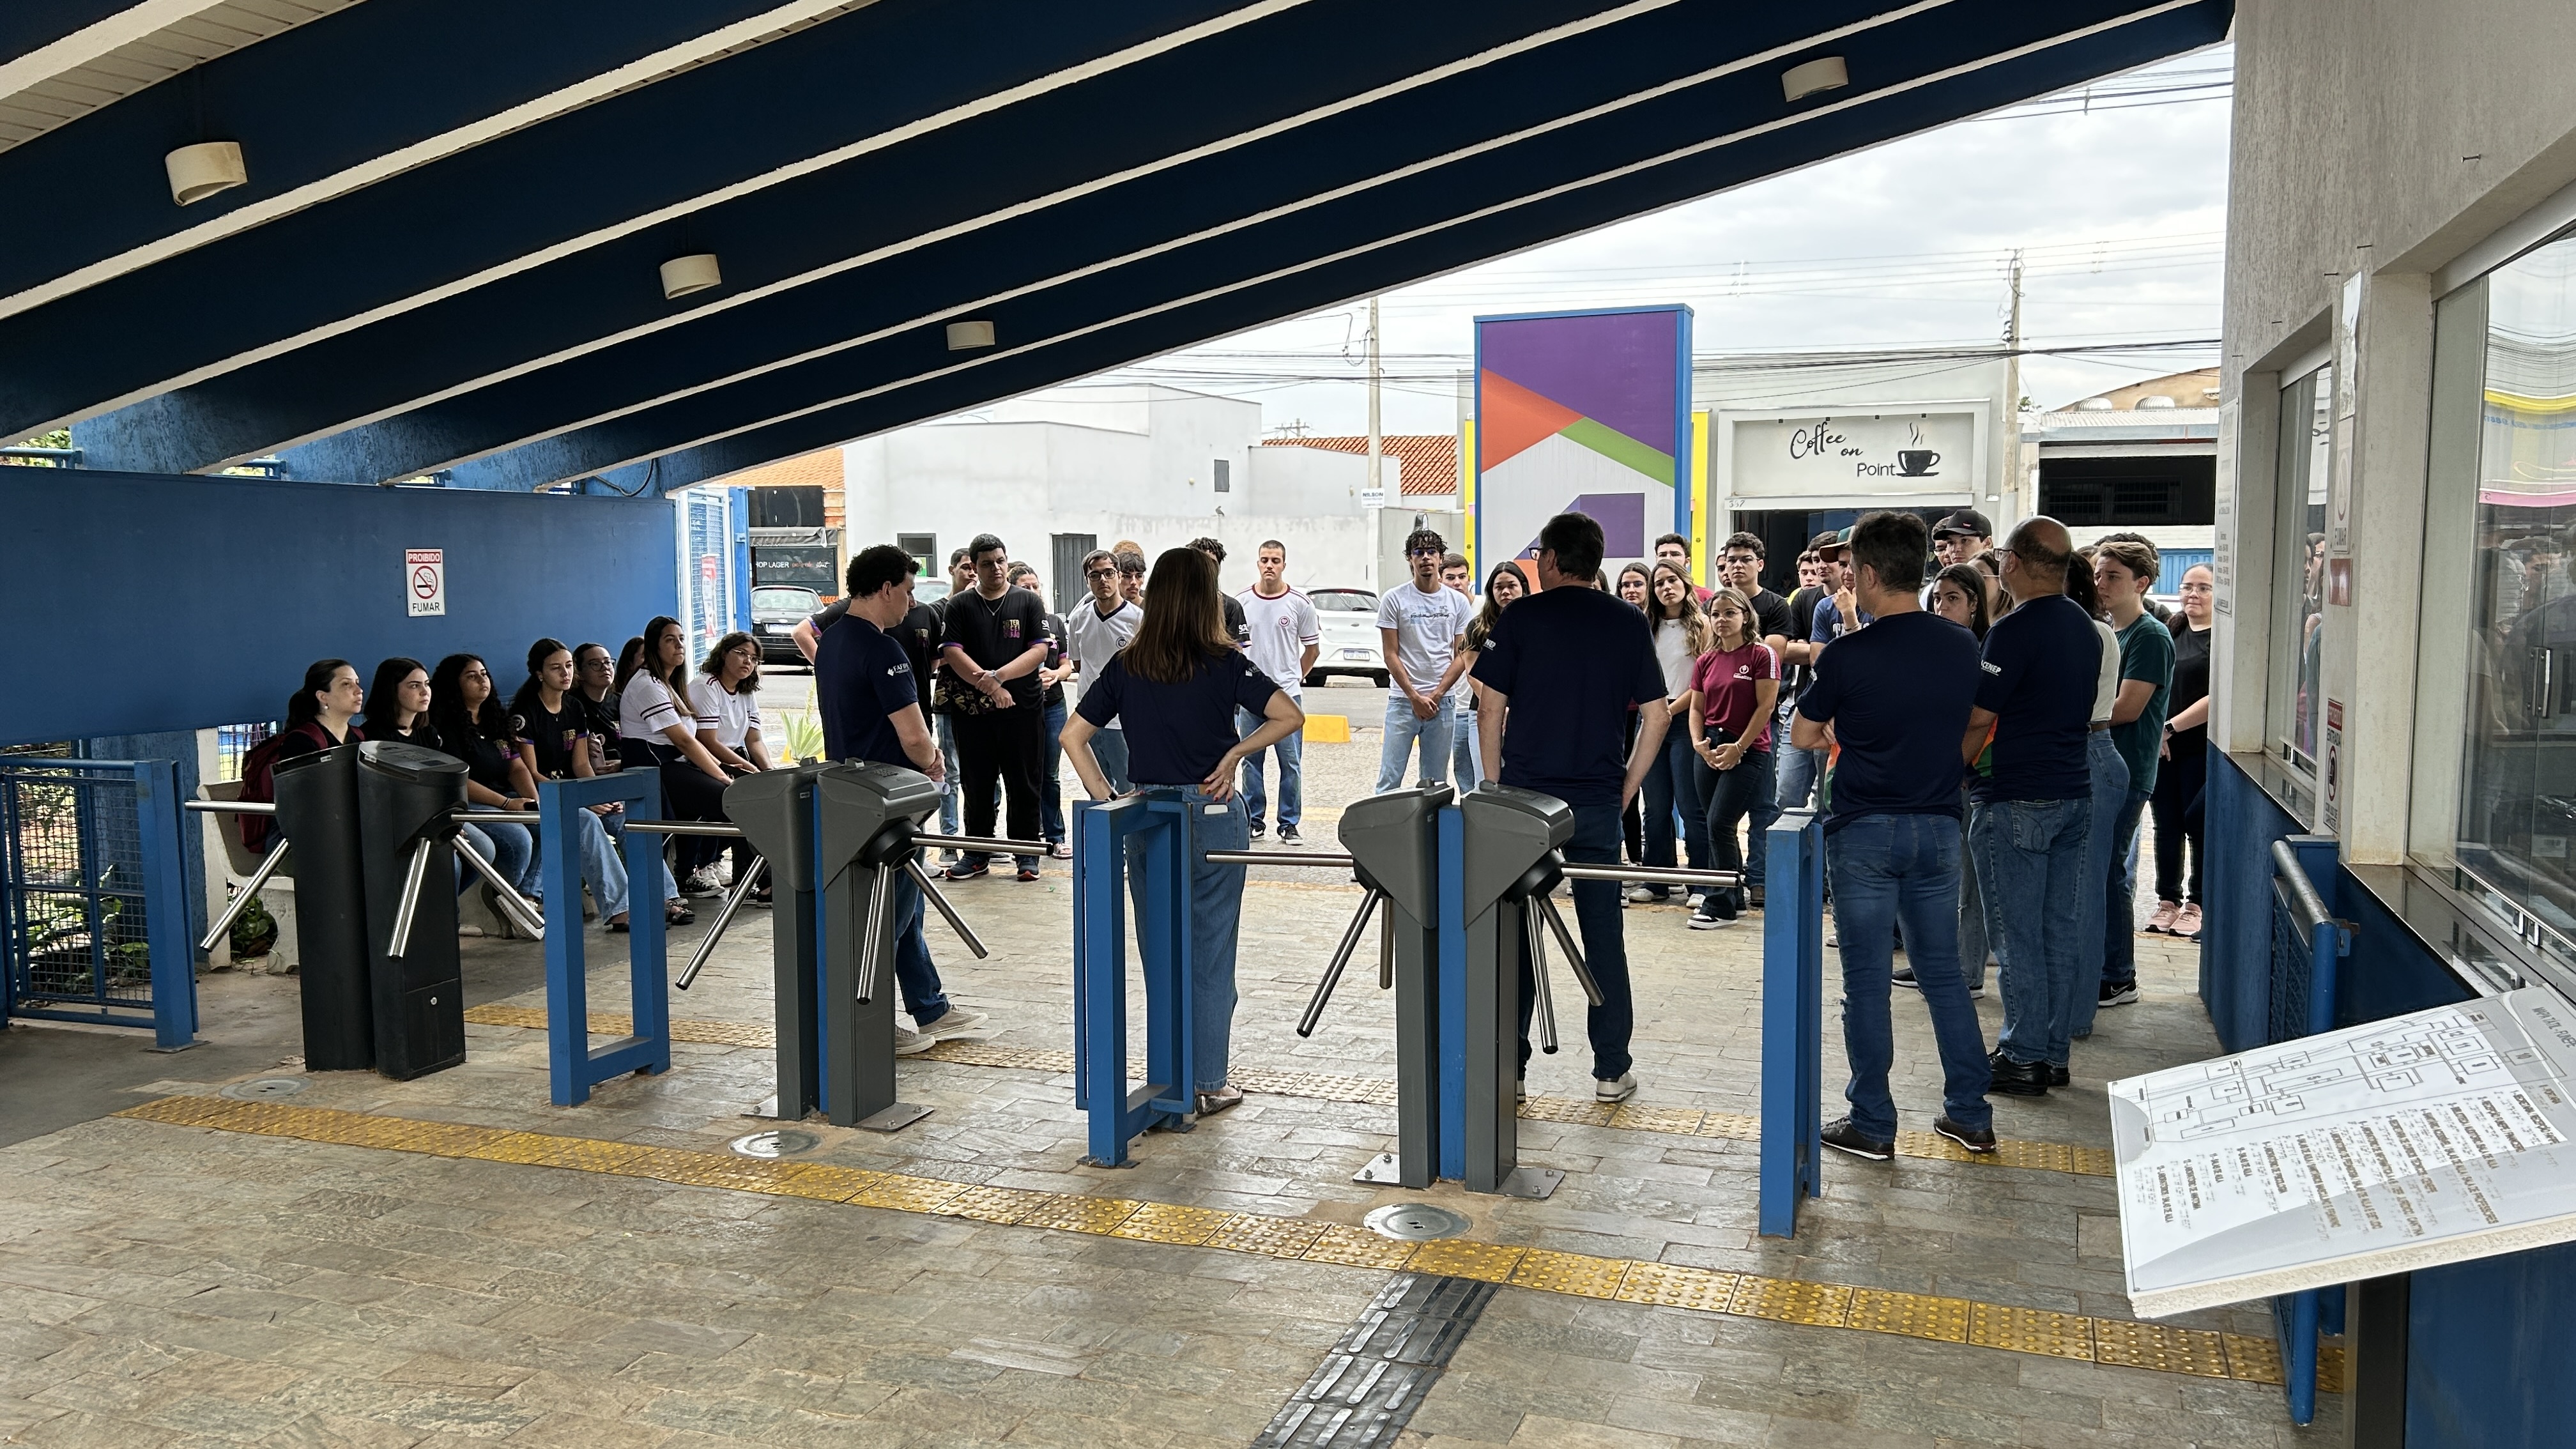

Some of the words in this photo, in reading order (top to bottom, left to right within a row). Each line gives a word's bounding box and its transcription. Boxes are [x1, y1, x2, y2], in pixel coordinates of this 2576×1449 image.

[1790, 421, 1846, 459] Coffee
[1841, 447, 1864, 457] on
[1857, 463, 1896, 477] Point
[408, 553, 440, 562] PROIBIDO
[412, 602, 441, 613] FUMAR
